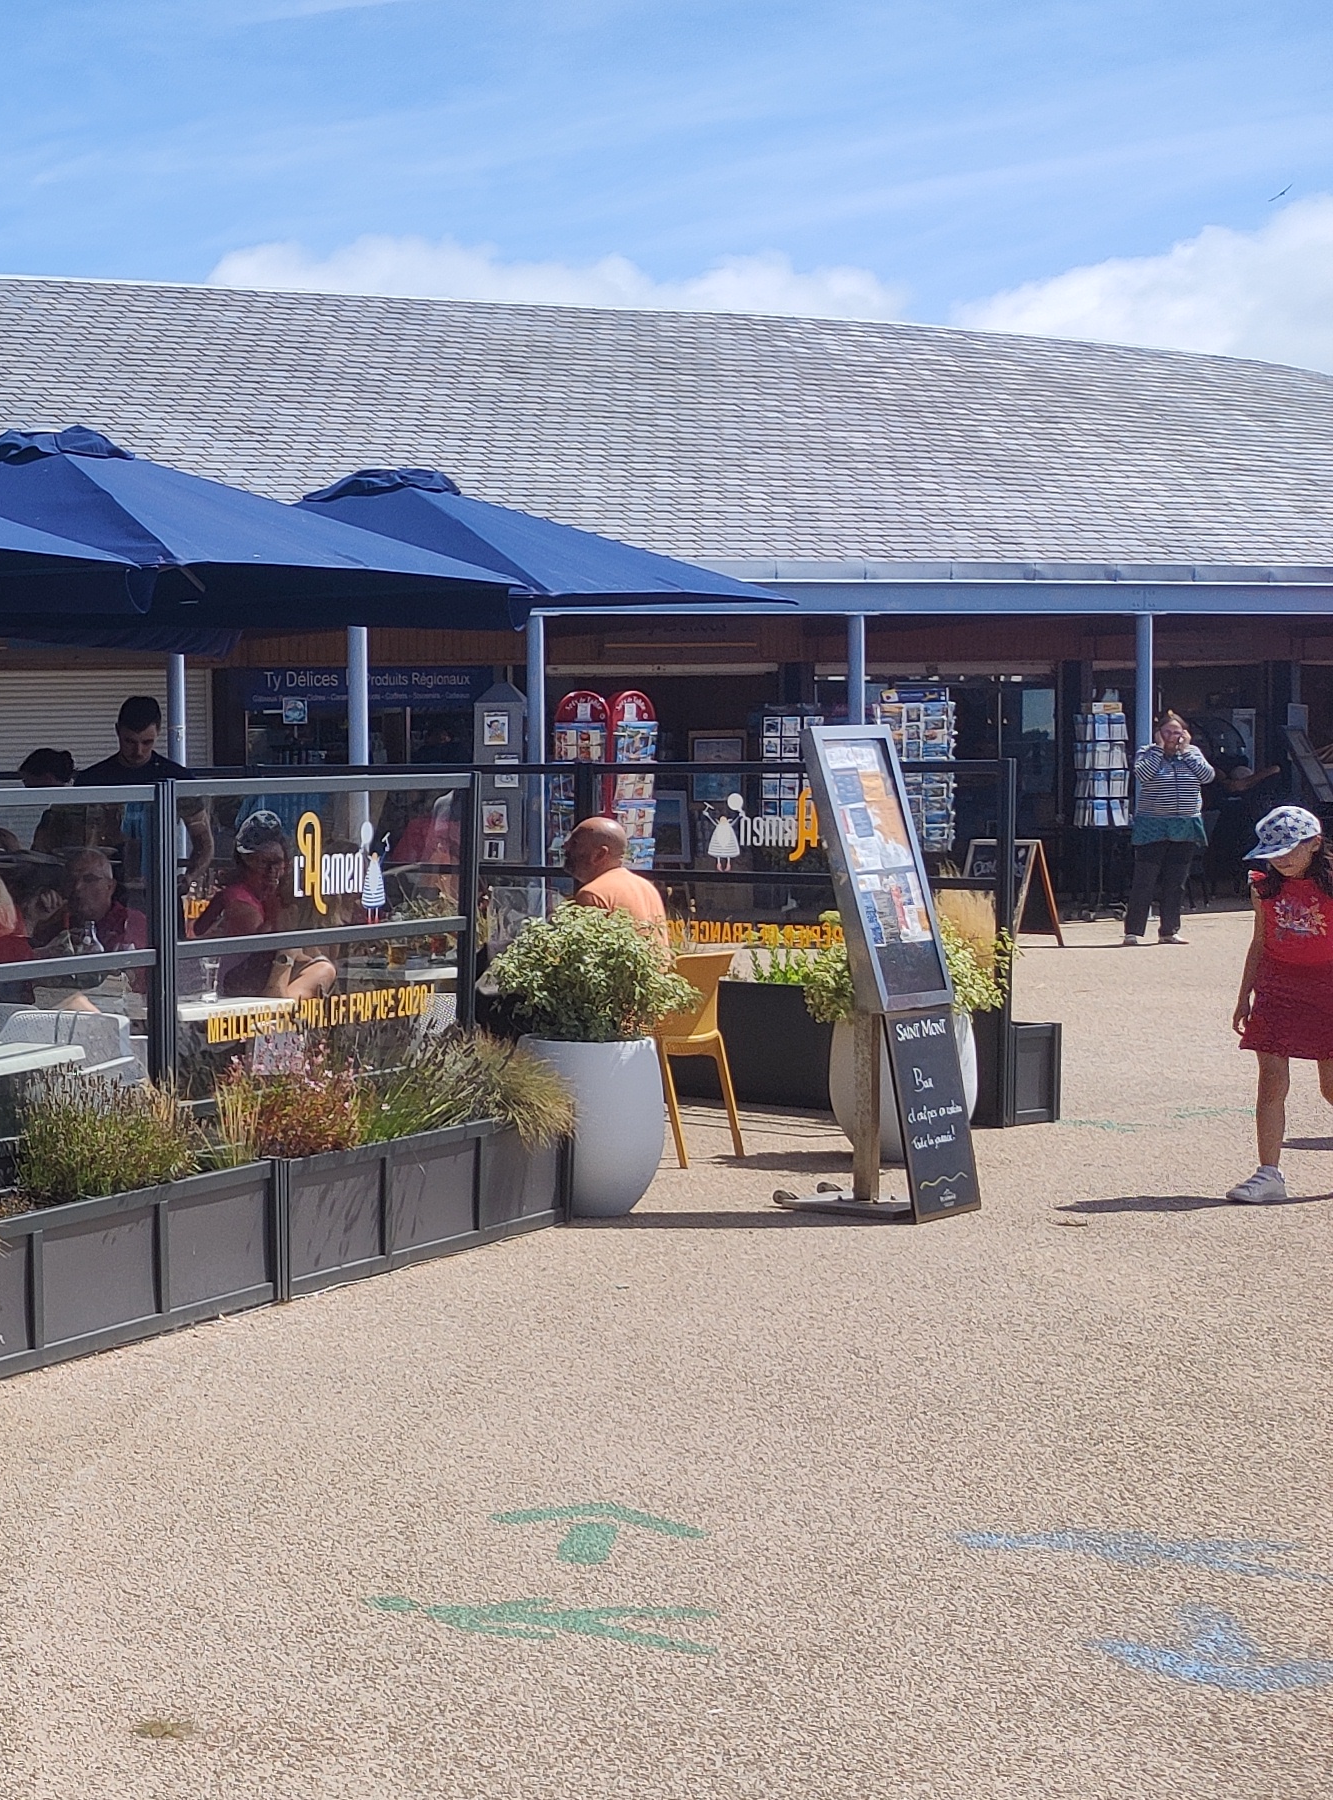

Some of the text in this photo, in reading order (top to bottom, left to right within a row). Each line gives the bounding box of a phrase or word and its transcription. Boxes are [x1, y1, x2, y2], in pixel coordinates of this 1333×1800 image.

[264, 671, 282, 692] Ty
[286, 670, 339, 688] Délices
[412, 672, 471, 689] Régionaux
[350, 988, 395, 1024] FRANCE
[398, 984, 427, 1017] 2020
[912, 1067, 934, 1092] Bar
